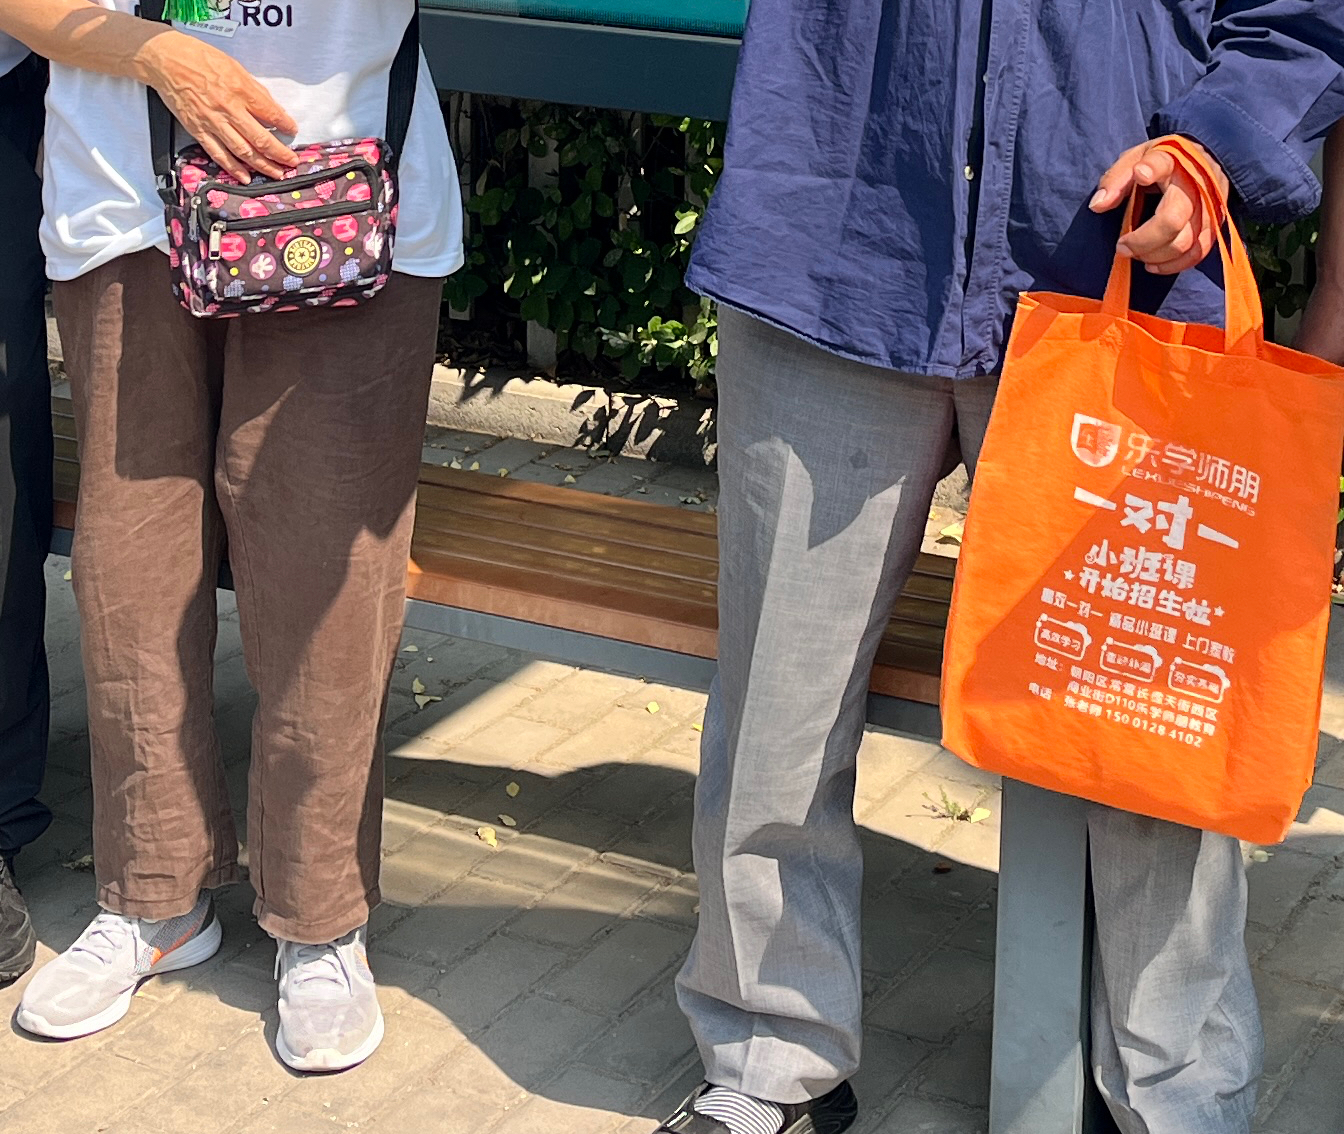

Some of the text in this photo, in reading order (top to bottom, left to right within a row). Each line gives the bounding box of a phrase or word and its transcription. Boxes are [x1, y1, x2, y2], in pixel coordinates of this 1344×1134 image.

[1124, 432, 1260, 503] 乐学师朋
[1073, 486, 1239, 551] 一对一
[1084, 539, 1197, 589] 小班课
[1079, 565, 1211, 626] 开始招生啦
[1106, 709, 1130, 725] 150
